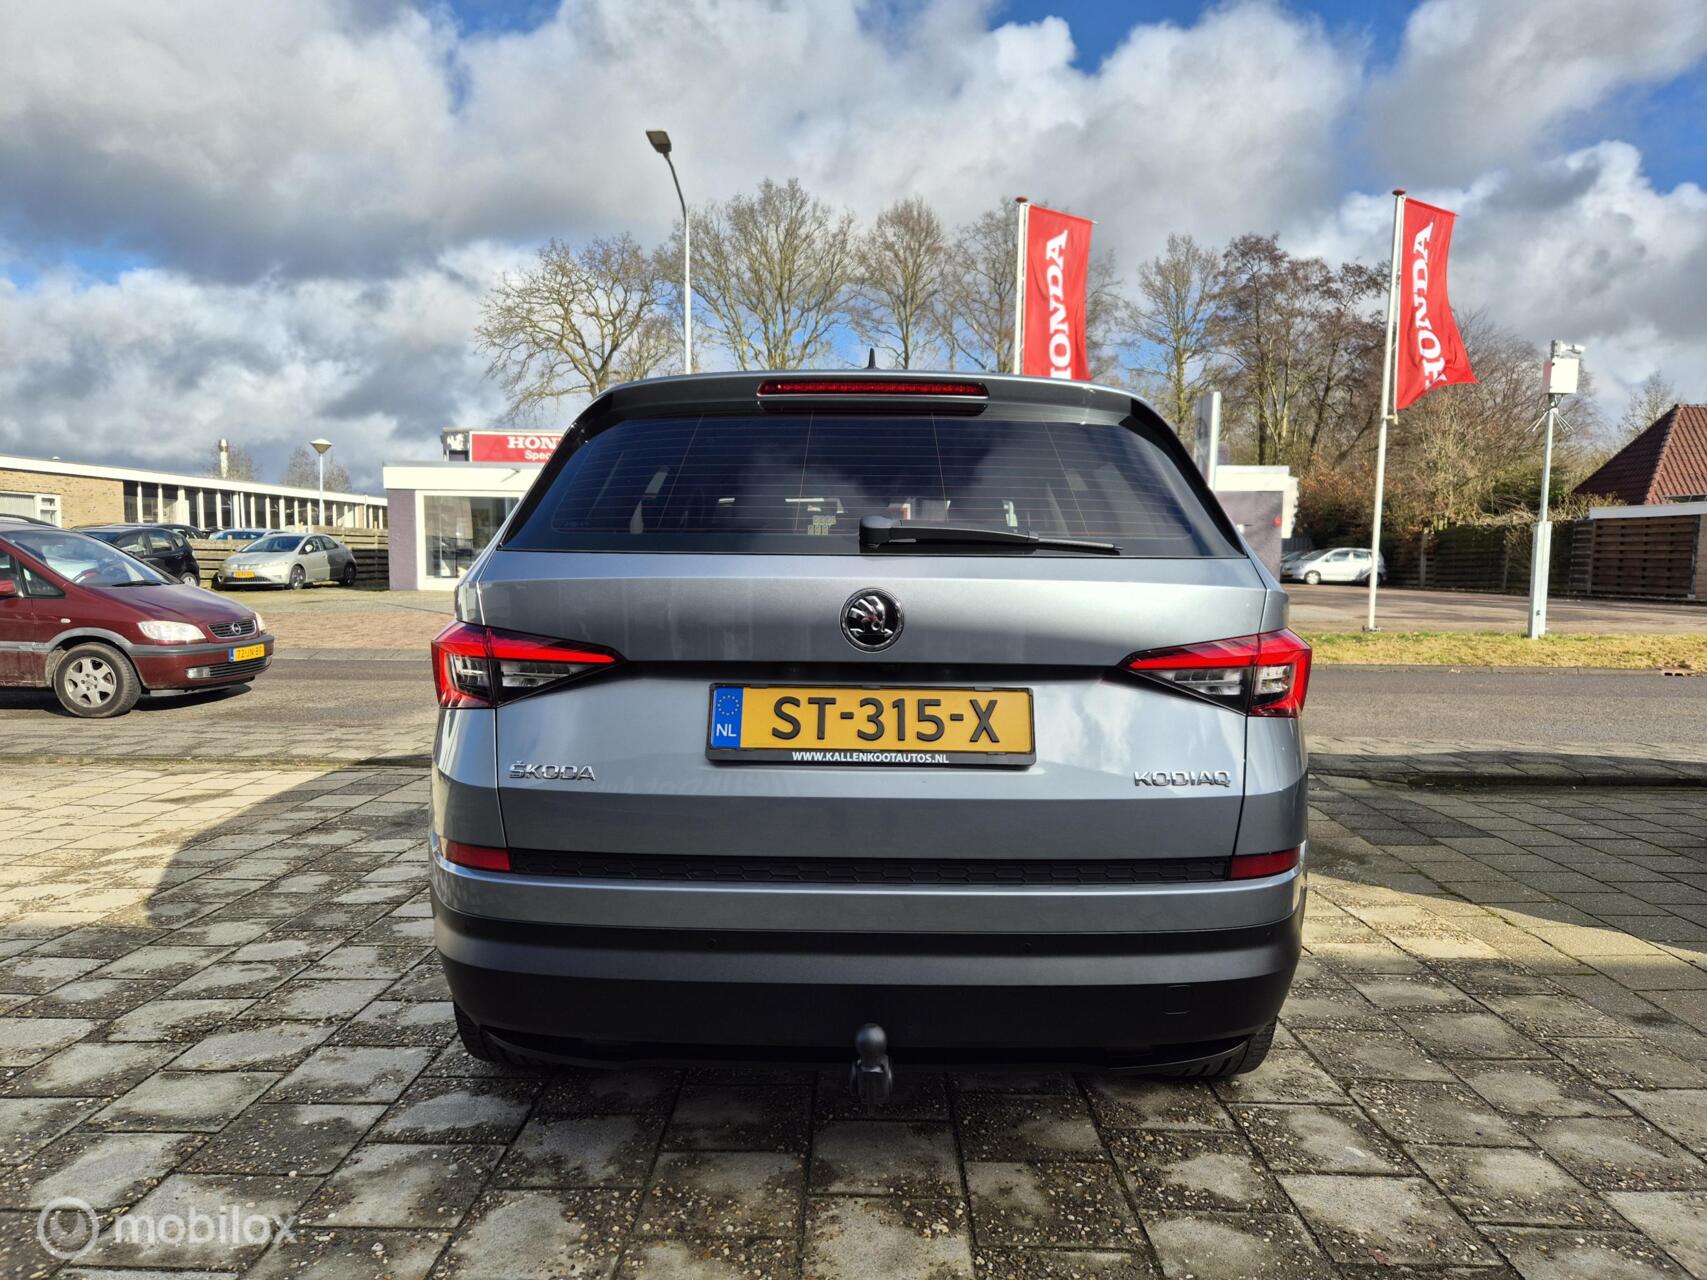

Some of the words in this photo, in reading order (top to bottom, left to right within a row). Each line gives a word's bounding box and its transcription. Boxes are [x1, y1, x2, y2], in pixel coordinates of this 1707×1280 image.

[771, 696, 1000, 743] ST-315-X
[715, 723, 737, 737] NL
[792, 751, 950, 764] WWW.KALLENKOOTAUTOS.NL
[509, 760, 596, 781] ŠKODA
[1133, 770, 1231, 788] KODIAQ
